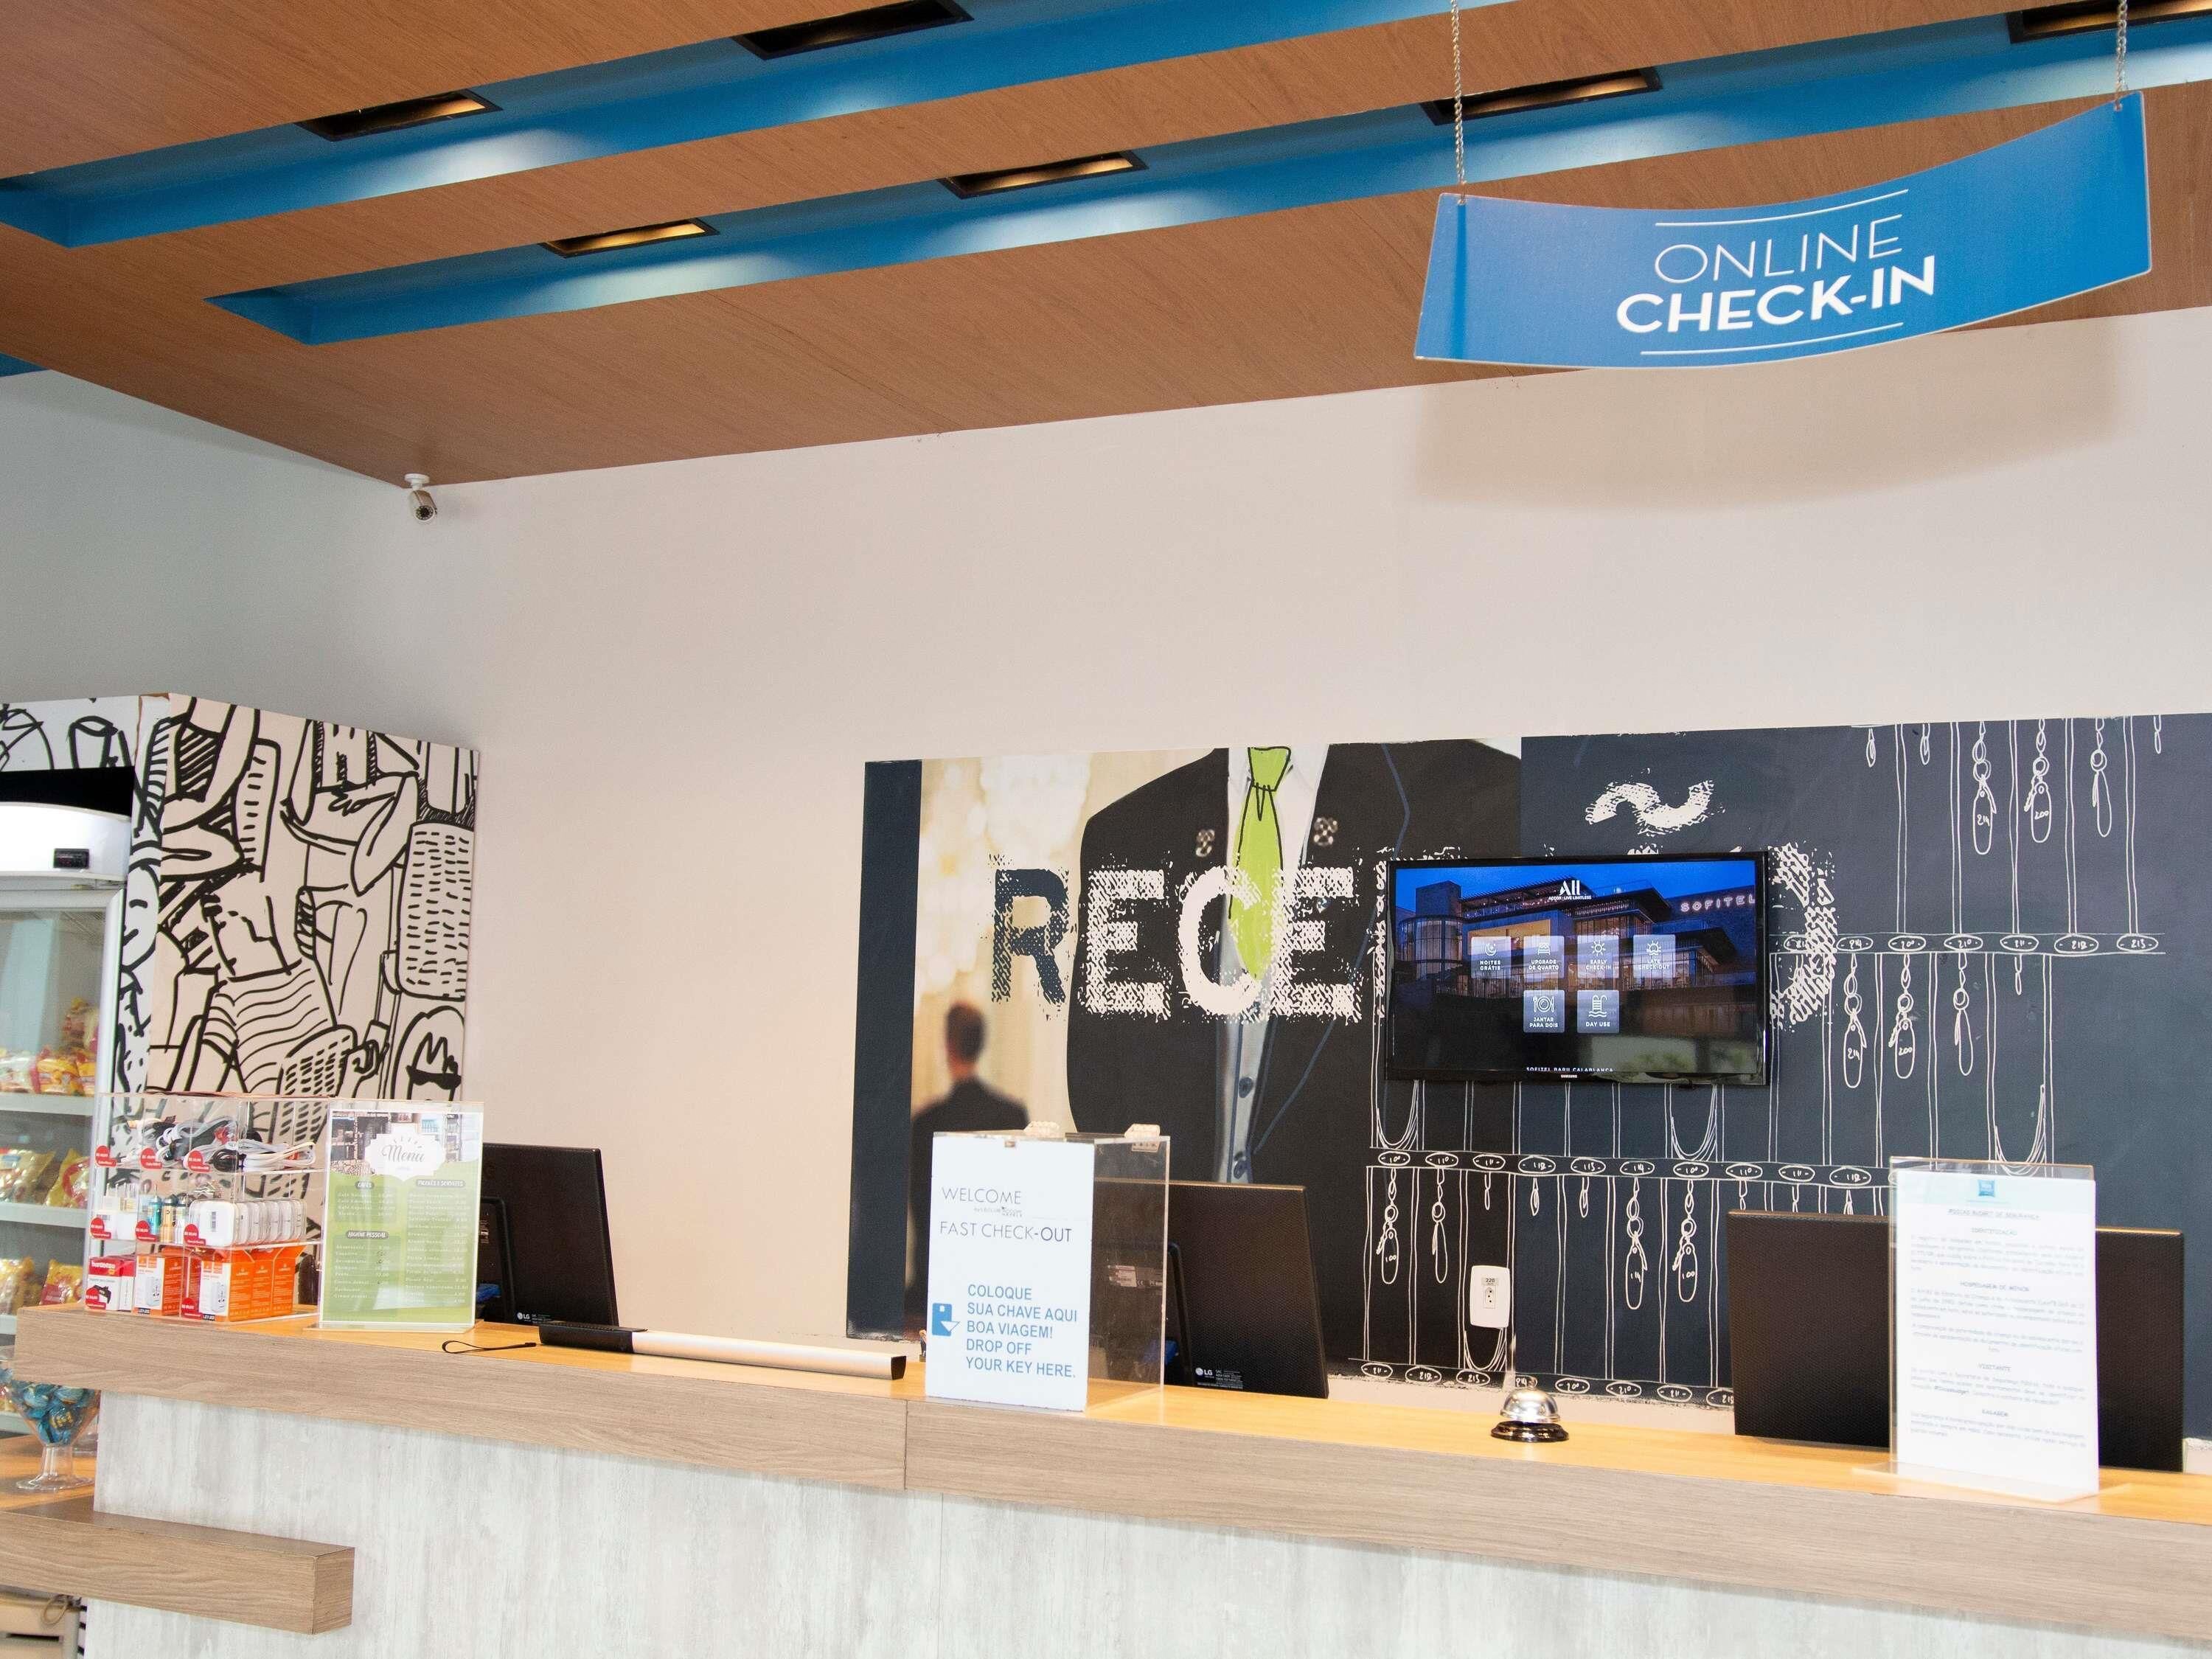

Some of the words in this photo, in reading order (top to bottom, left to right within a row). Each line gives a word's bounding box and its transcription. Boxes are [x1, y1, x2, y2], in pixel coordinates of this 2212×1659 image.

[1654, 214, 1904, 284] ONLINE
[1617, 254, 1935, 334] CHECK-IN
[1680, 894, 1755, 912] SOFITEL
[942, 1186, 1021, 1205] WELCOME
[940, 1221, 977, 1236] FAST
[981, 1222, 1073, 1242] CHECK-OUT
[967, 1284, 1032, 1300] COLOQUE
[967, 1302, 994, 1316] SUA
[997, 1304, 1041, 1319] CHAVE
[1044, 1308, 1077, 1322] AQUI
[967, 1320, 995, 1334] BOA
[998, 1322, 1053, 1339] VIAGEM!
[967, 1338, 1003, 1352] DROP
[1006, 1341, 1032, 1355] OFF
[966, 1356, 1002, 1371] YOUR
[1006, 1360, 1032, 1374] KEY
[1037, 1363, 1076, 1378] HERE.
